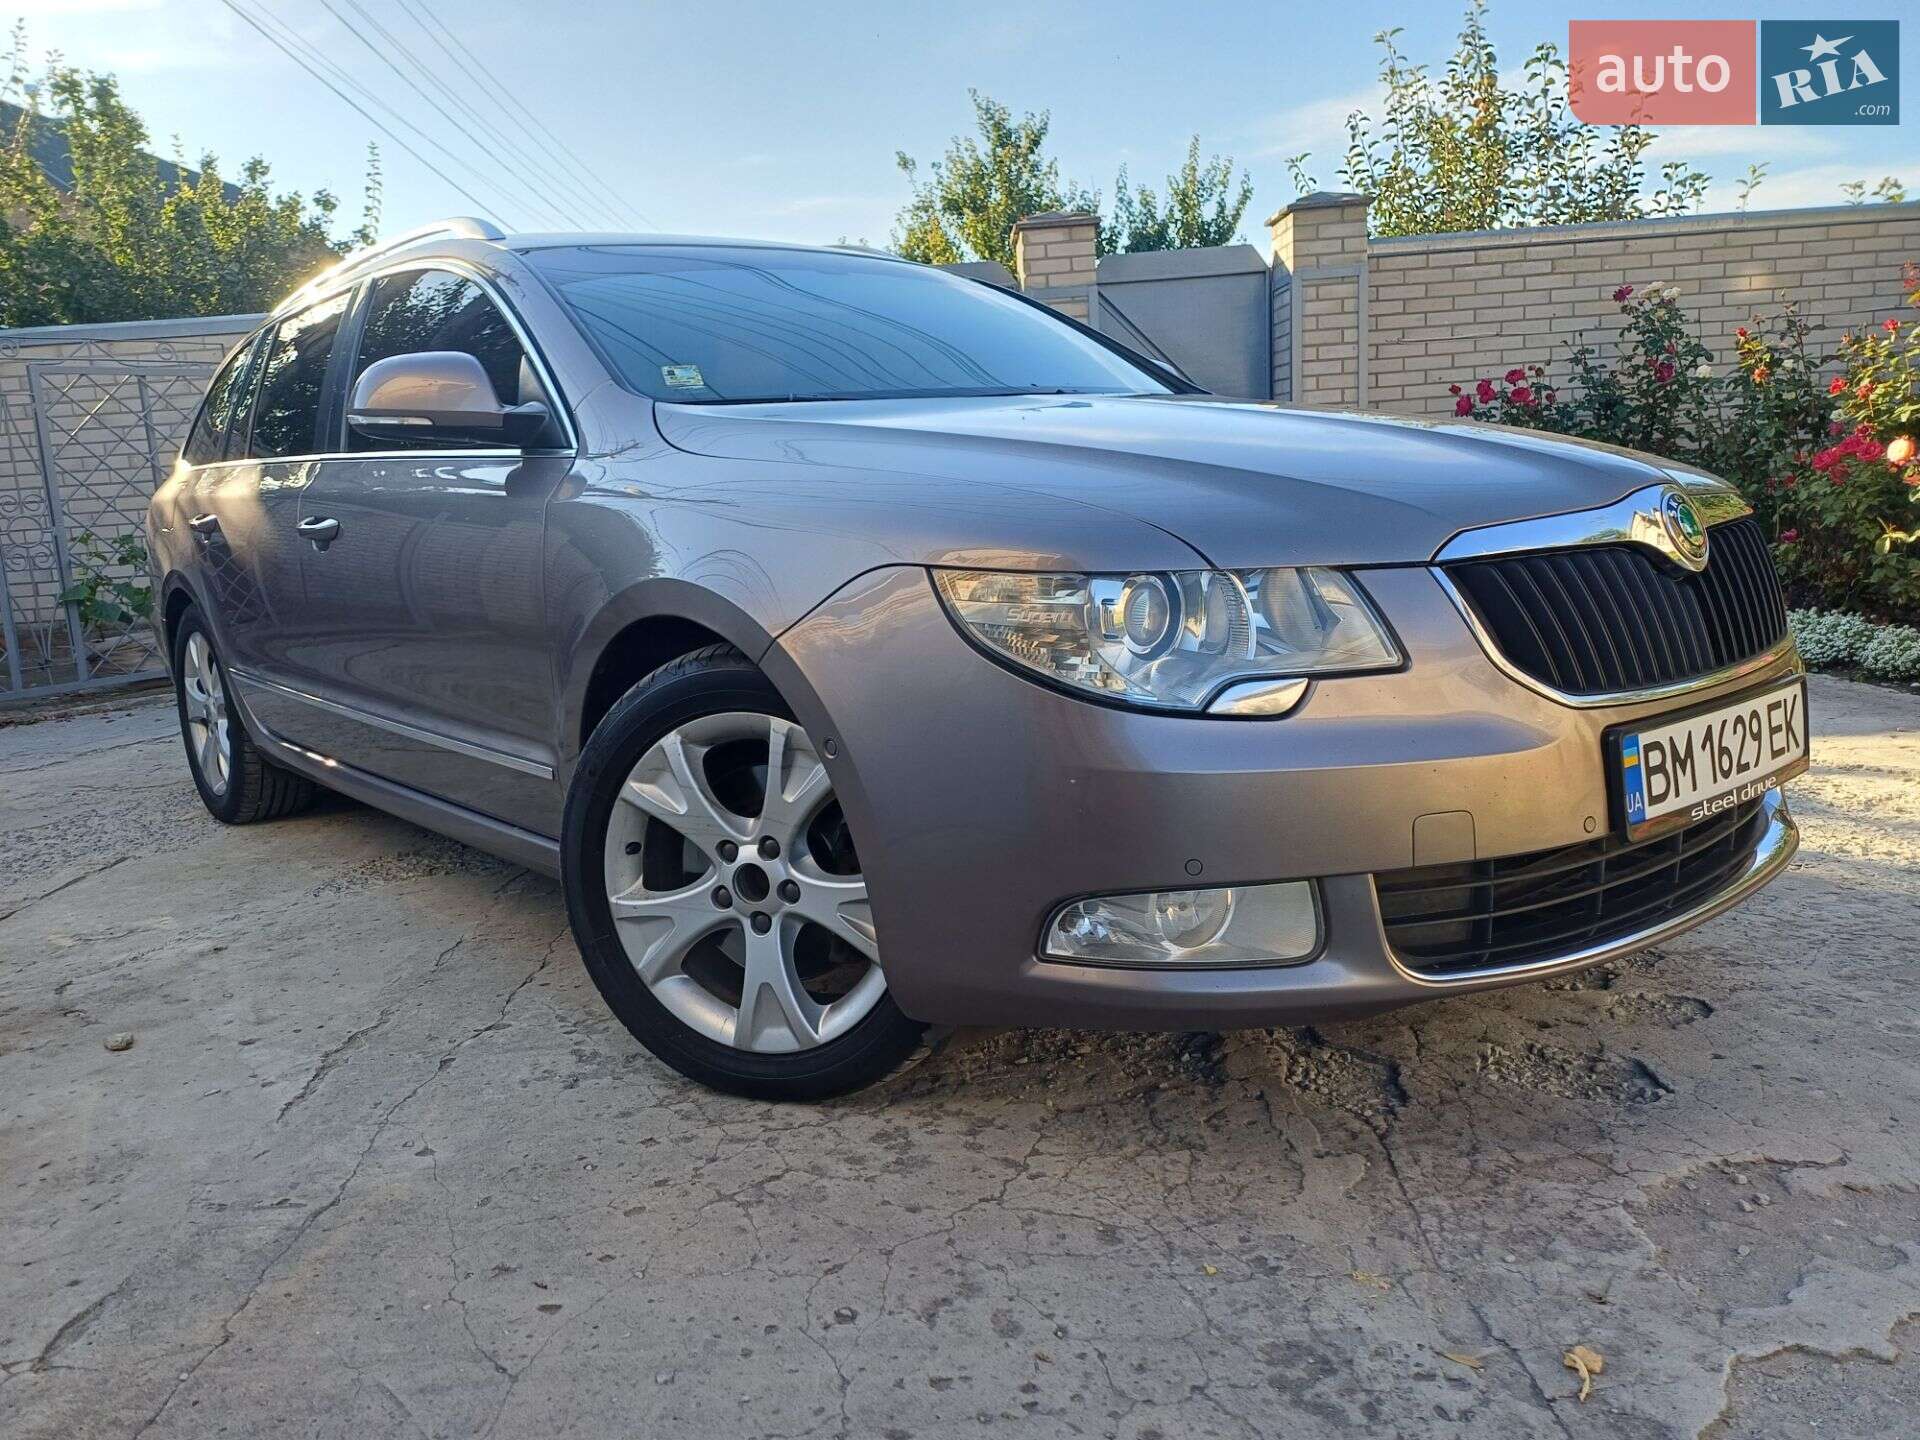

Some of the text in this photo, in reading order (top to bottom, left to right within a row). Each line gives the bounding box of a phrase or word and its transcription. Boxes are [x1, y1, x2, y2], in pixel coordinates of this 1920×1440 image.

[1643, 693, 1800, 807] BM 1629 EK
[1626, 791, 1644, 813] UA
[1691, 776, 1777, 821] steel drive
